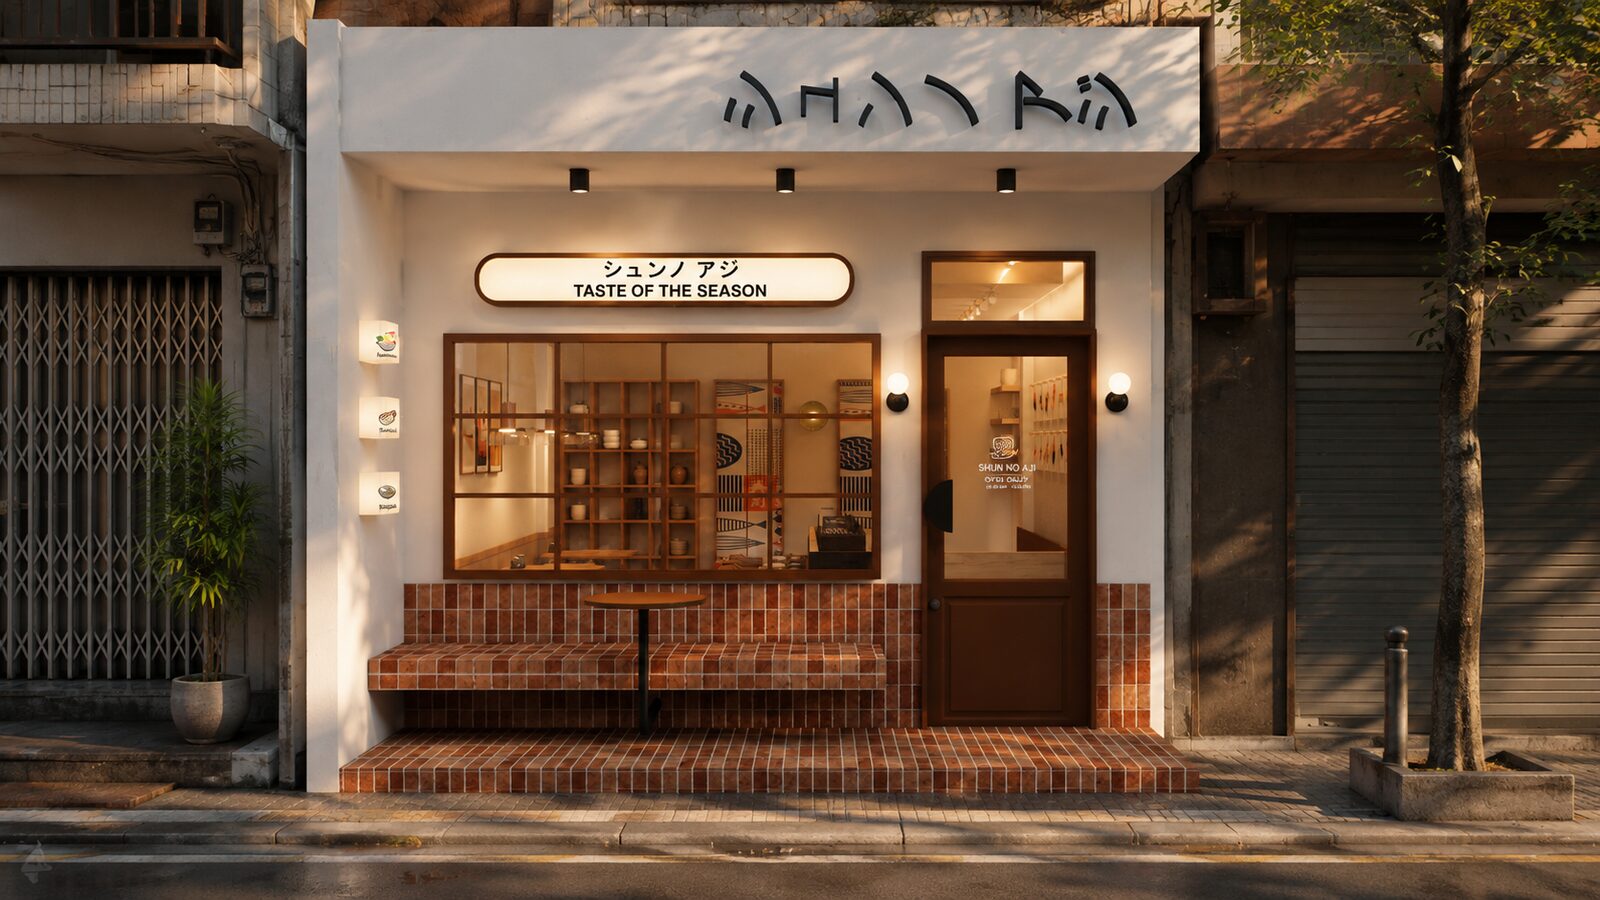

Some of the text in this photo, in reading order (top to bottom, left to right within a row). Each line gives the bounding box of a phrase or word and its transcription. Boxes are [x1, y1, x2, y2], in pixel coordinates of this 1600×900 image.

[604, 259, 739, 279] シュンノ アジ
[573, 284, 767, 298] TASTE OF THE SEASON
[978, 463, 1037, 472] SHUN NO AJI
